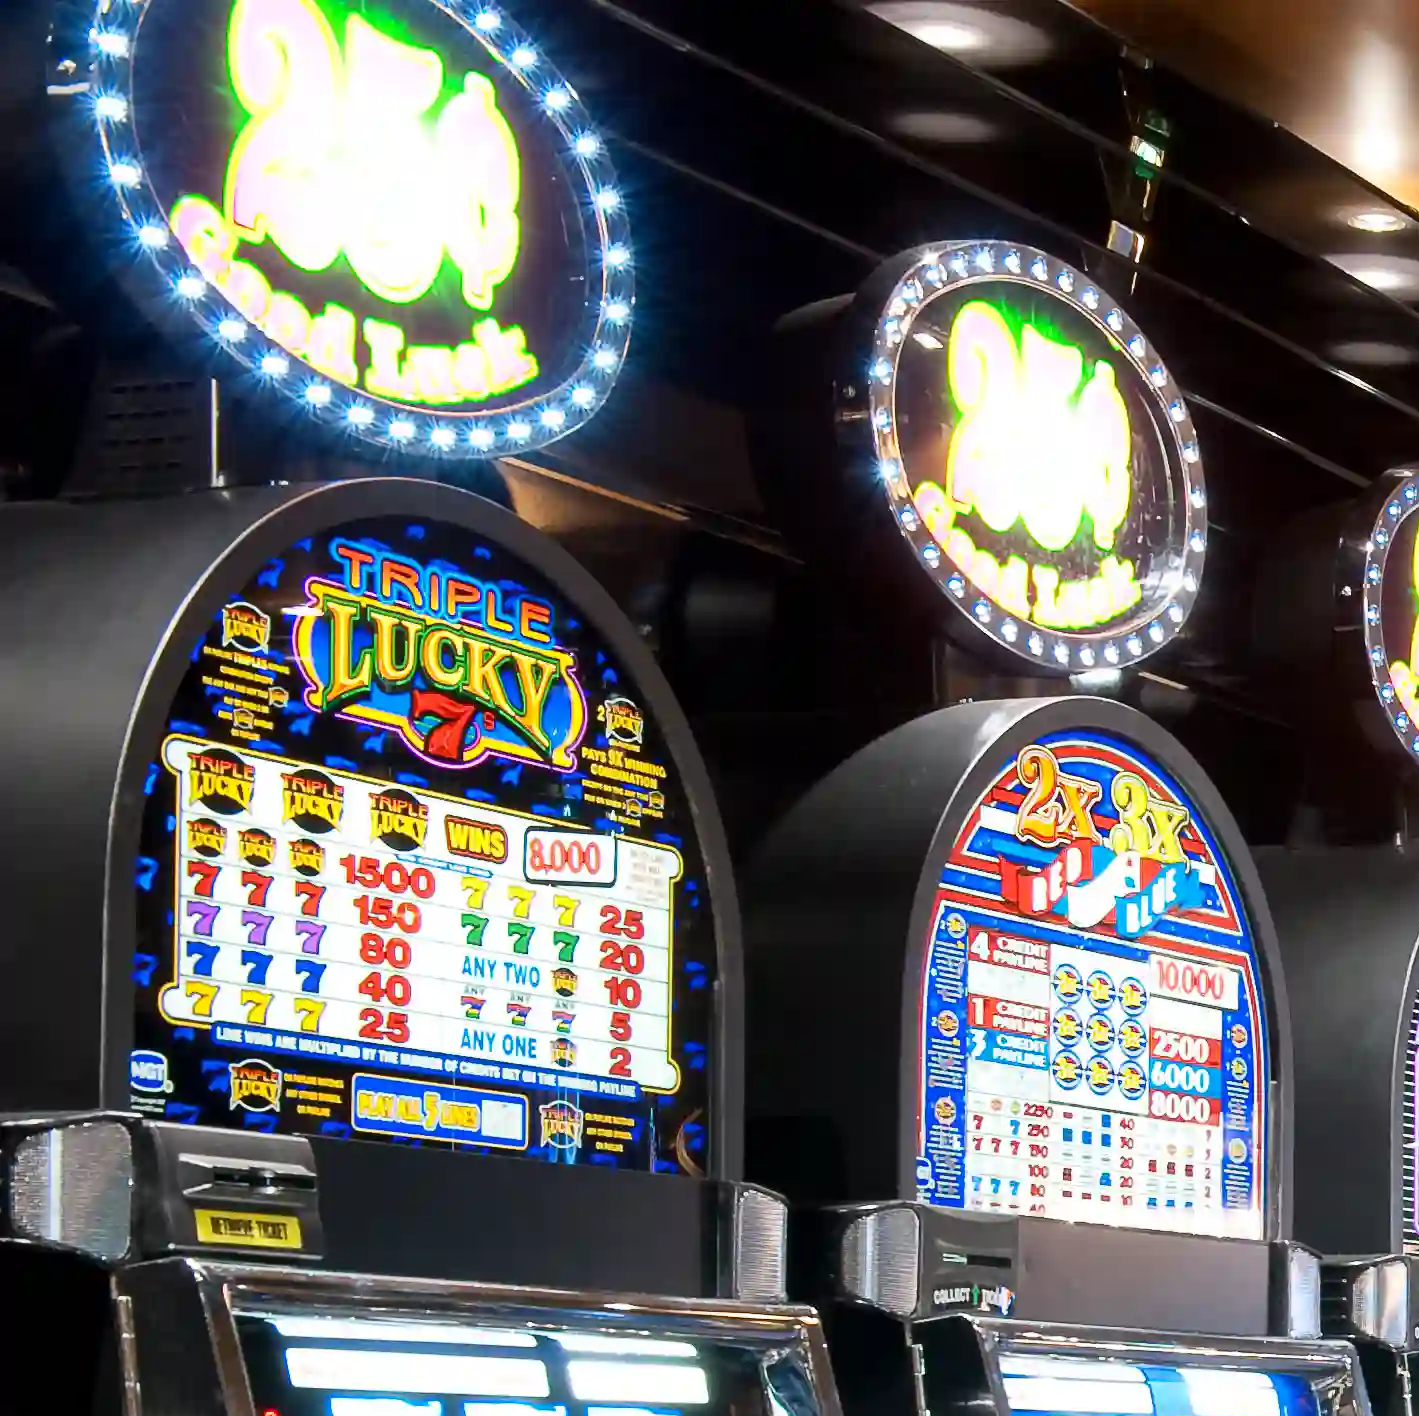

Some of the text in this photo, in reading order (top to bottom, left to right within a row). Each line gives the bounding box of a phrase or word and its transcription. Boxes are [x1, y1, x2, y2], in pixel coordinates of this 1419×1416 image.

[335, 542, 556, 646] TRIPLE
[321, 596, 560, 758] LUCKY
[187, 752, 255, 782] TRIPLE
[189, 770, 254, 813] LUCKY
[281, 773, 345, 800] TRIPLE
[1017, 744, 1102, 848] 2X
[282, 791, 344, 831] LUCKY
[369, 792, 429, 818] TRIPLE
[369, 810, 428, 848] LUCKY
[447, 821, 505, 860] WINS
[339, 853, 436, 899] 1500
[353, 894, 422, 934] 150
[599, 904, 645, 939] 25
[358, 932, 412, 970] 80
[599, 940, 645, 975] 20
[970, 931, 991, 961] 4
[358, 971, 412, 1007] 40
[462, 955, 541, 988] ANY TWO
[604, 976, 642, 1009] 10
[358, 1007, 411, 1043] 25
[609, 1011, 632, 1042] 5
[972, 997, 985, 1025] 1
[460, 1028, 538, 1060] ANY ONE
[1152, 1030, 1210, 1064] 2500
[609, 1046, 633, 1079] 2
[1151, 1060, 1210, 1094] 6000
[356, 1090, 394, 1119] PLAY
[423, 1092, 440, 1131] 5
[1151, 1090, 1211, 1124] 8000
[933, 1287, 970, 1305] COLLECT
